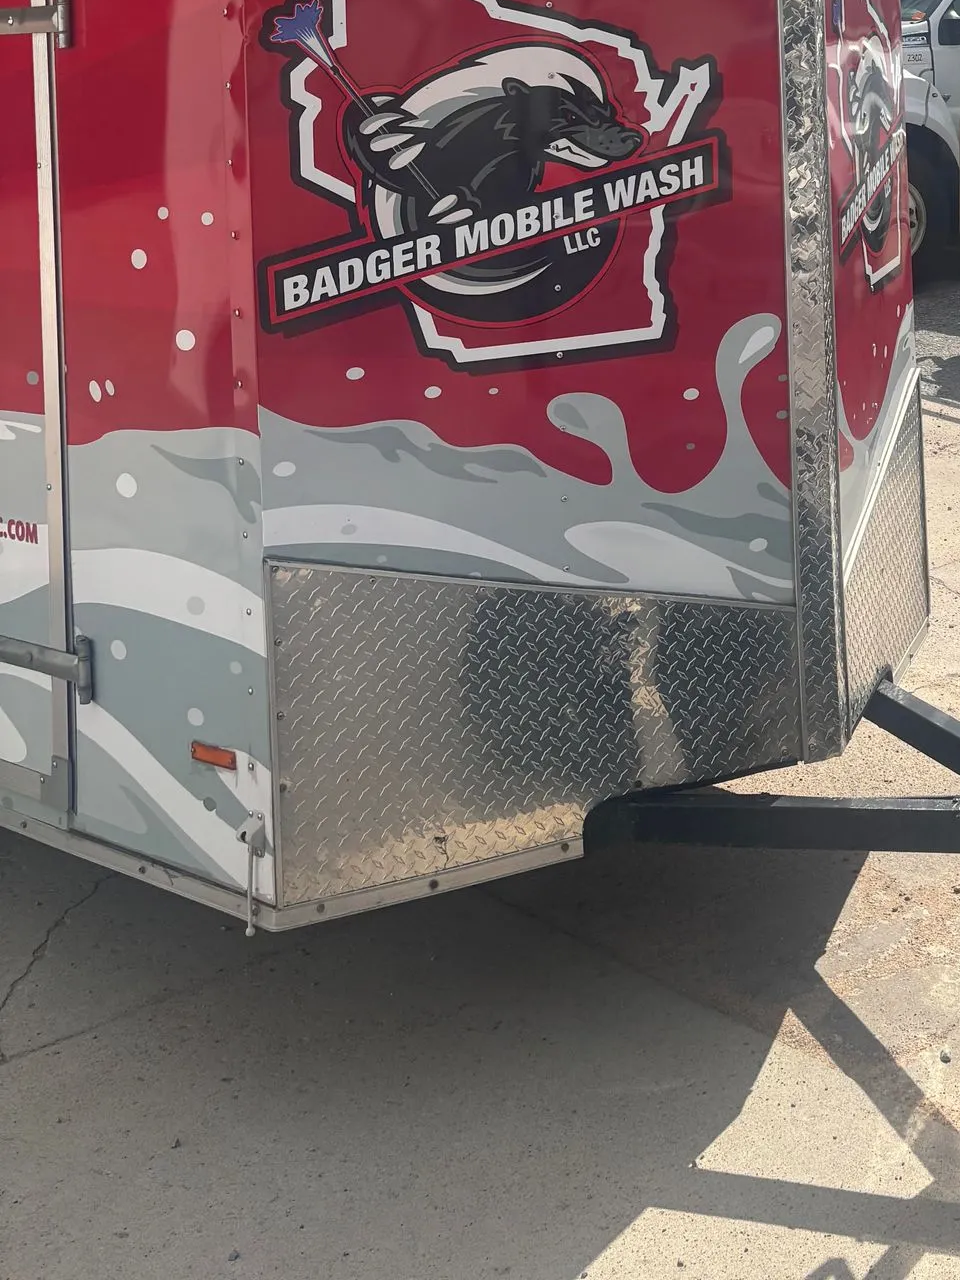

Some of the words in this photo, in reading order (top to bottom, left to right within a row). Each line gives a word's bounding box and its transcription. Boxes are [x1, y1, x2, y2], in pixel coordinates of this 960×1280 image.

[282, 232, 442, 312] BADGER
[455, 187, 596, 260] MOBILE
[603, 155, 705, 213] WASH
[564, 227, 601, 256] LLC
